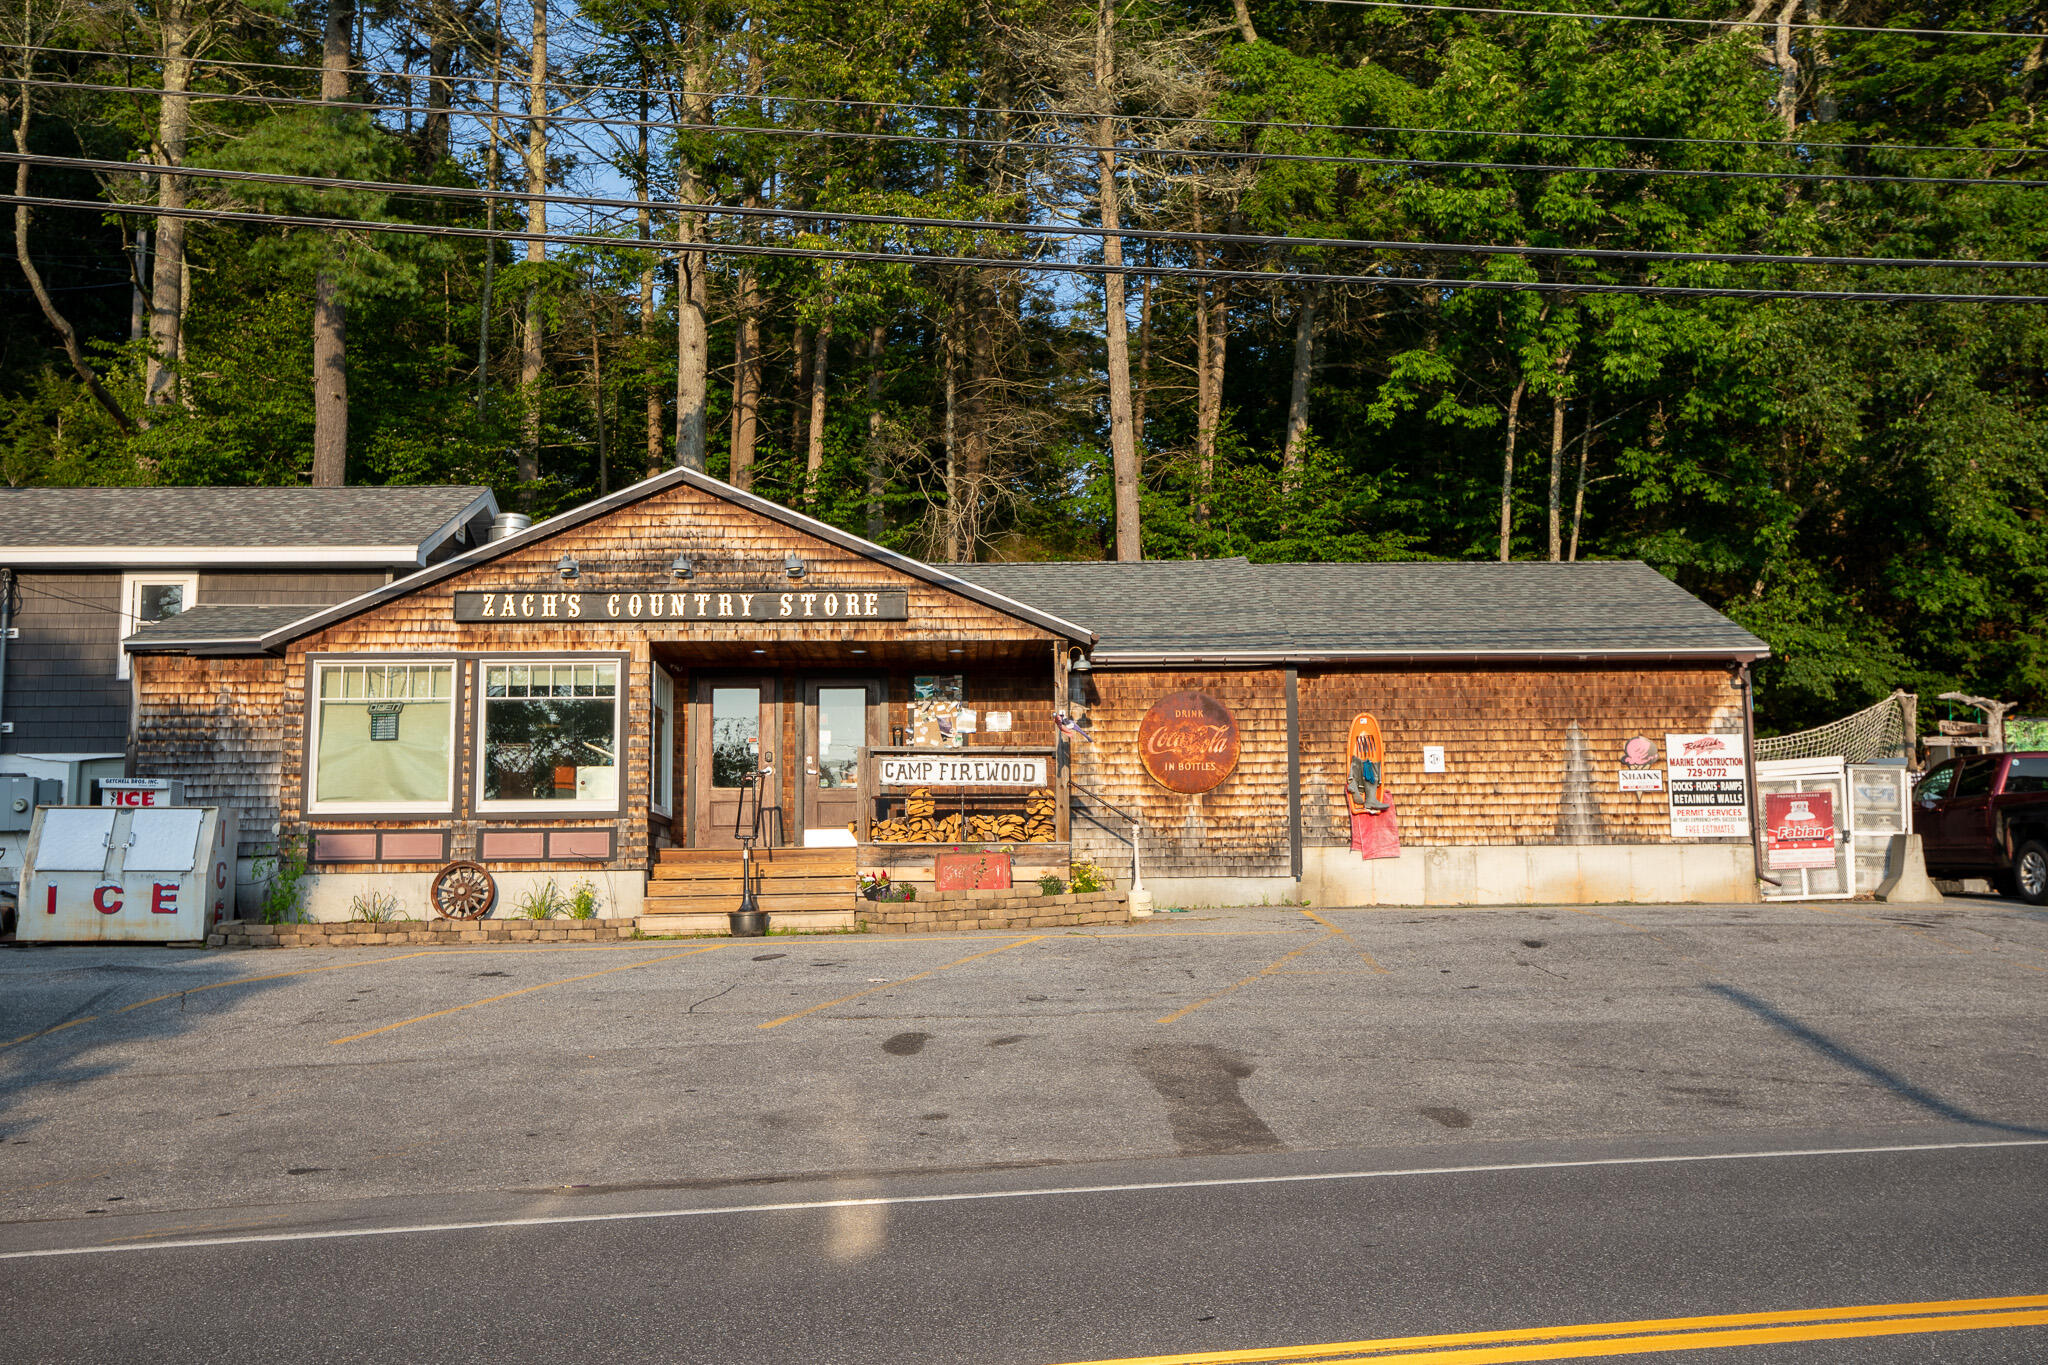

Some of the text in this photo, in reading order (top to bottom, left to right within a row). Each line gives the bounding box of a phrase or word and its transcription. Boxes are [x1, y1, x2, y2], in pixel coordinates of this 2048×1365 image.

[482, 593, 878, 618] ZACH'S COUNTRY STORE
[1175, 709, 1204, 718] DRINK
[1164, 762, 1217, 771] IN BOTTLES
[1669, 757, 1744, 767] MARINE CONSTRUCTION
[885, 762, 1036, 782] CAMP FIREWOOD
[1672, 781, 1743, 791] DOCKS FLOATS RAMPS
[116, 791, 156, 806] ICE
[1673, 793, 1743, 804] RETAINING WALLS
[1676, 809, 1704, 817] PERMIT
[1685, 824, 1736, 834] FREE ESTIMATES
[1777, 825, 1825, 839] Fabian
[47, 880, 180, 915] ICE
